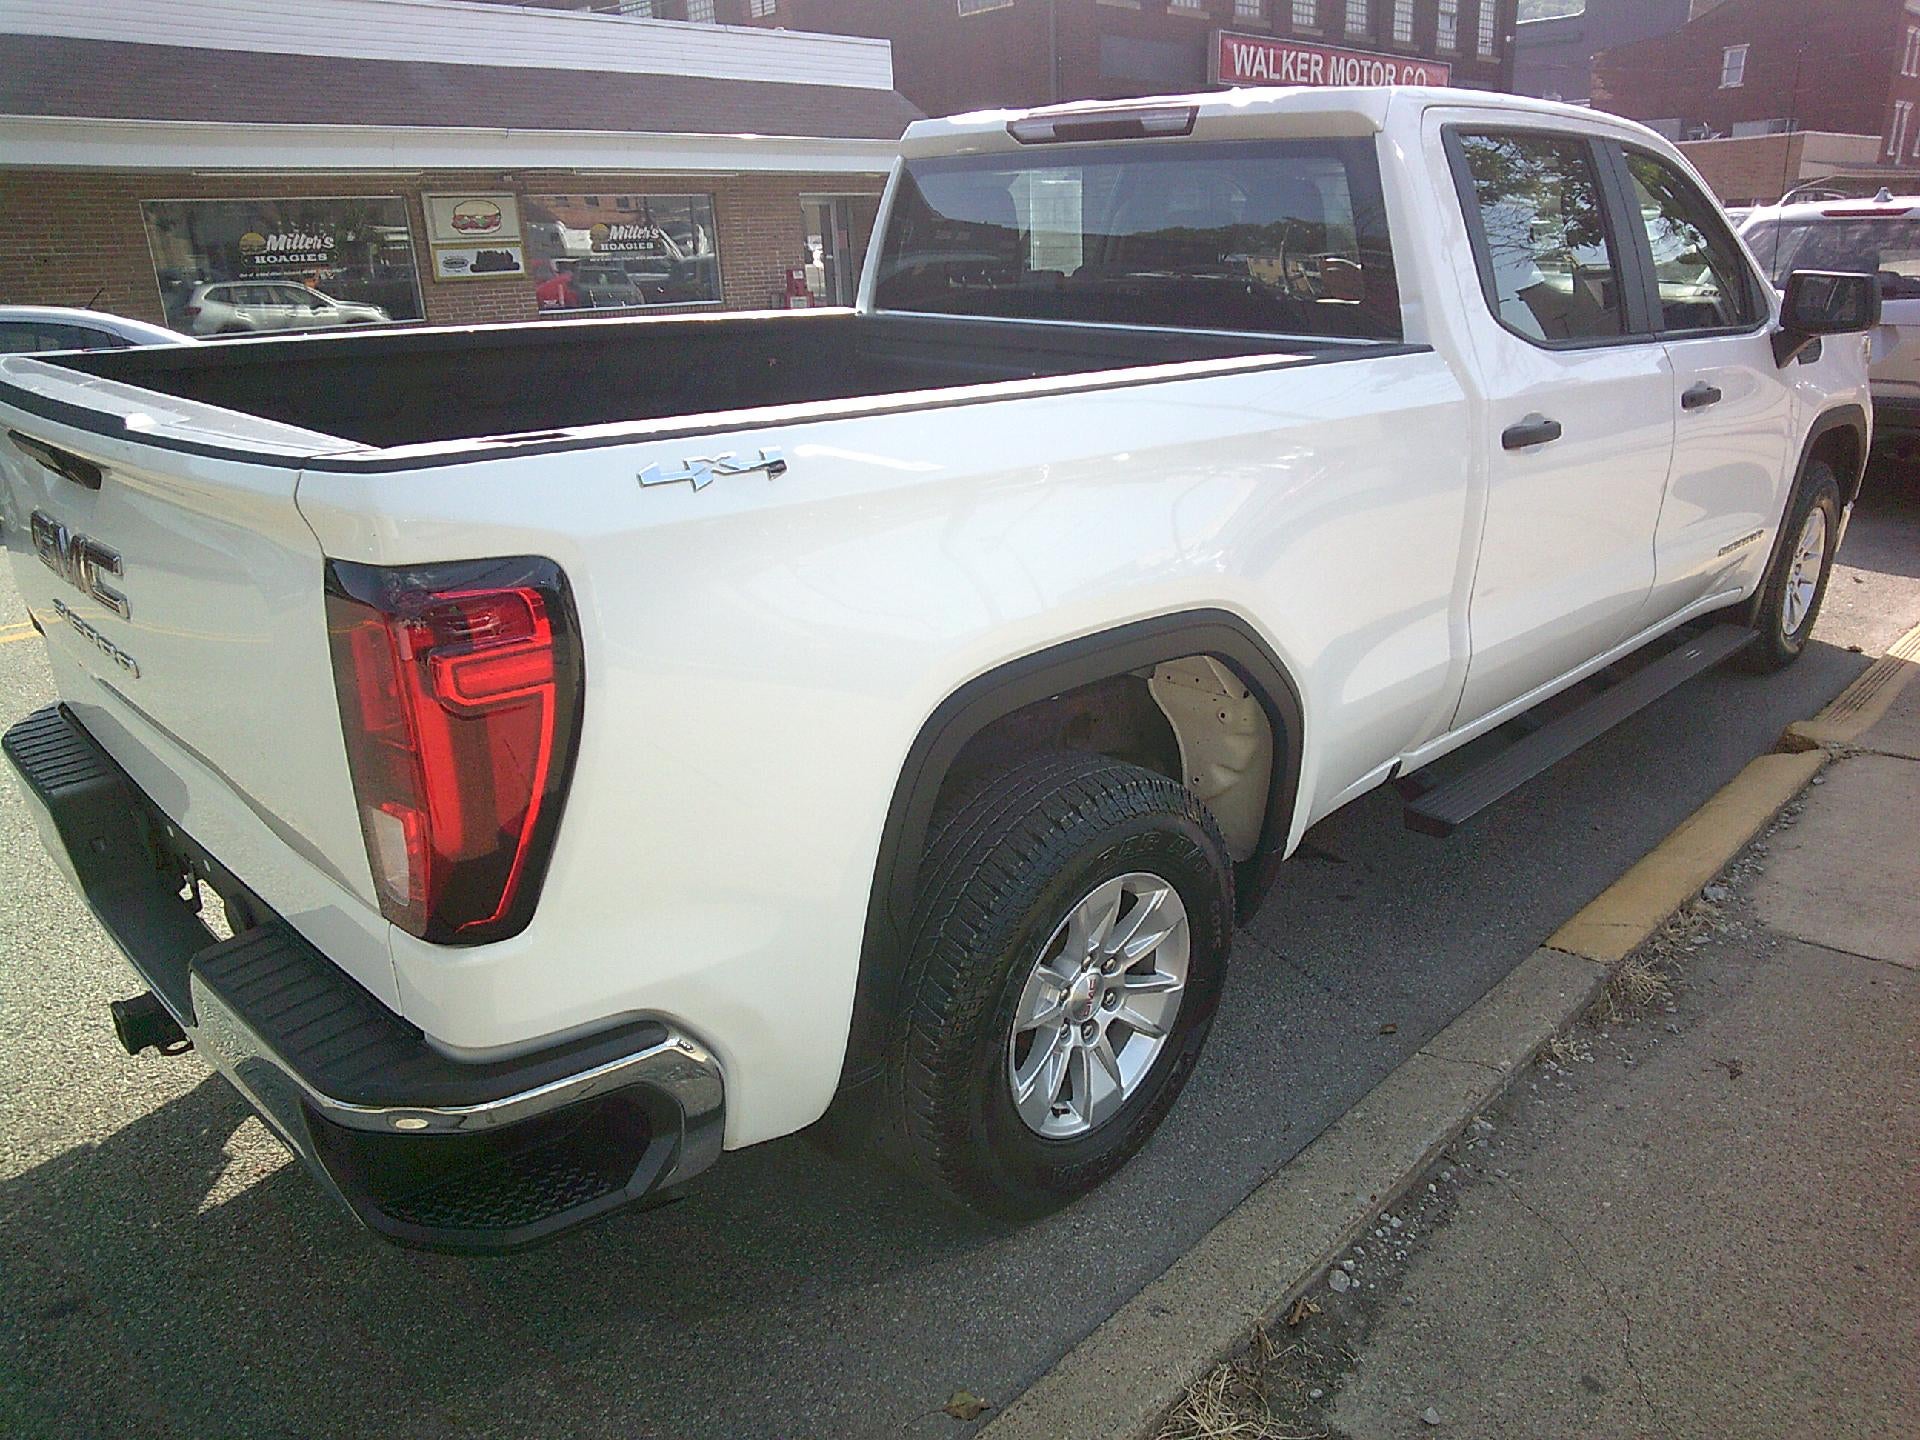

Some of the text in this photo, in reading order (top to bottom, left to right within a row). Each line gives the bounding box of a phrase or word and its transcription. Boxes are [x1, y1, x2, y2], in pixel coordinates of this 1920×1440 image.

[1233, 43, 1324, 85] WALKER
[1329, 56, 1396, 86] MOTOR
[609, 224, 660, 241] Miller's
[266, 233, 335, 251] Miller's
[600, 242, 654, 251] HOAGIES
[254, 253, 328, 264] HOAGIES
